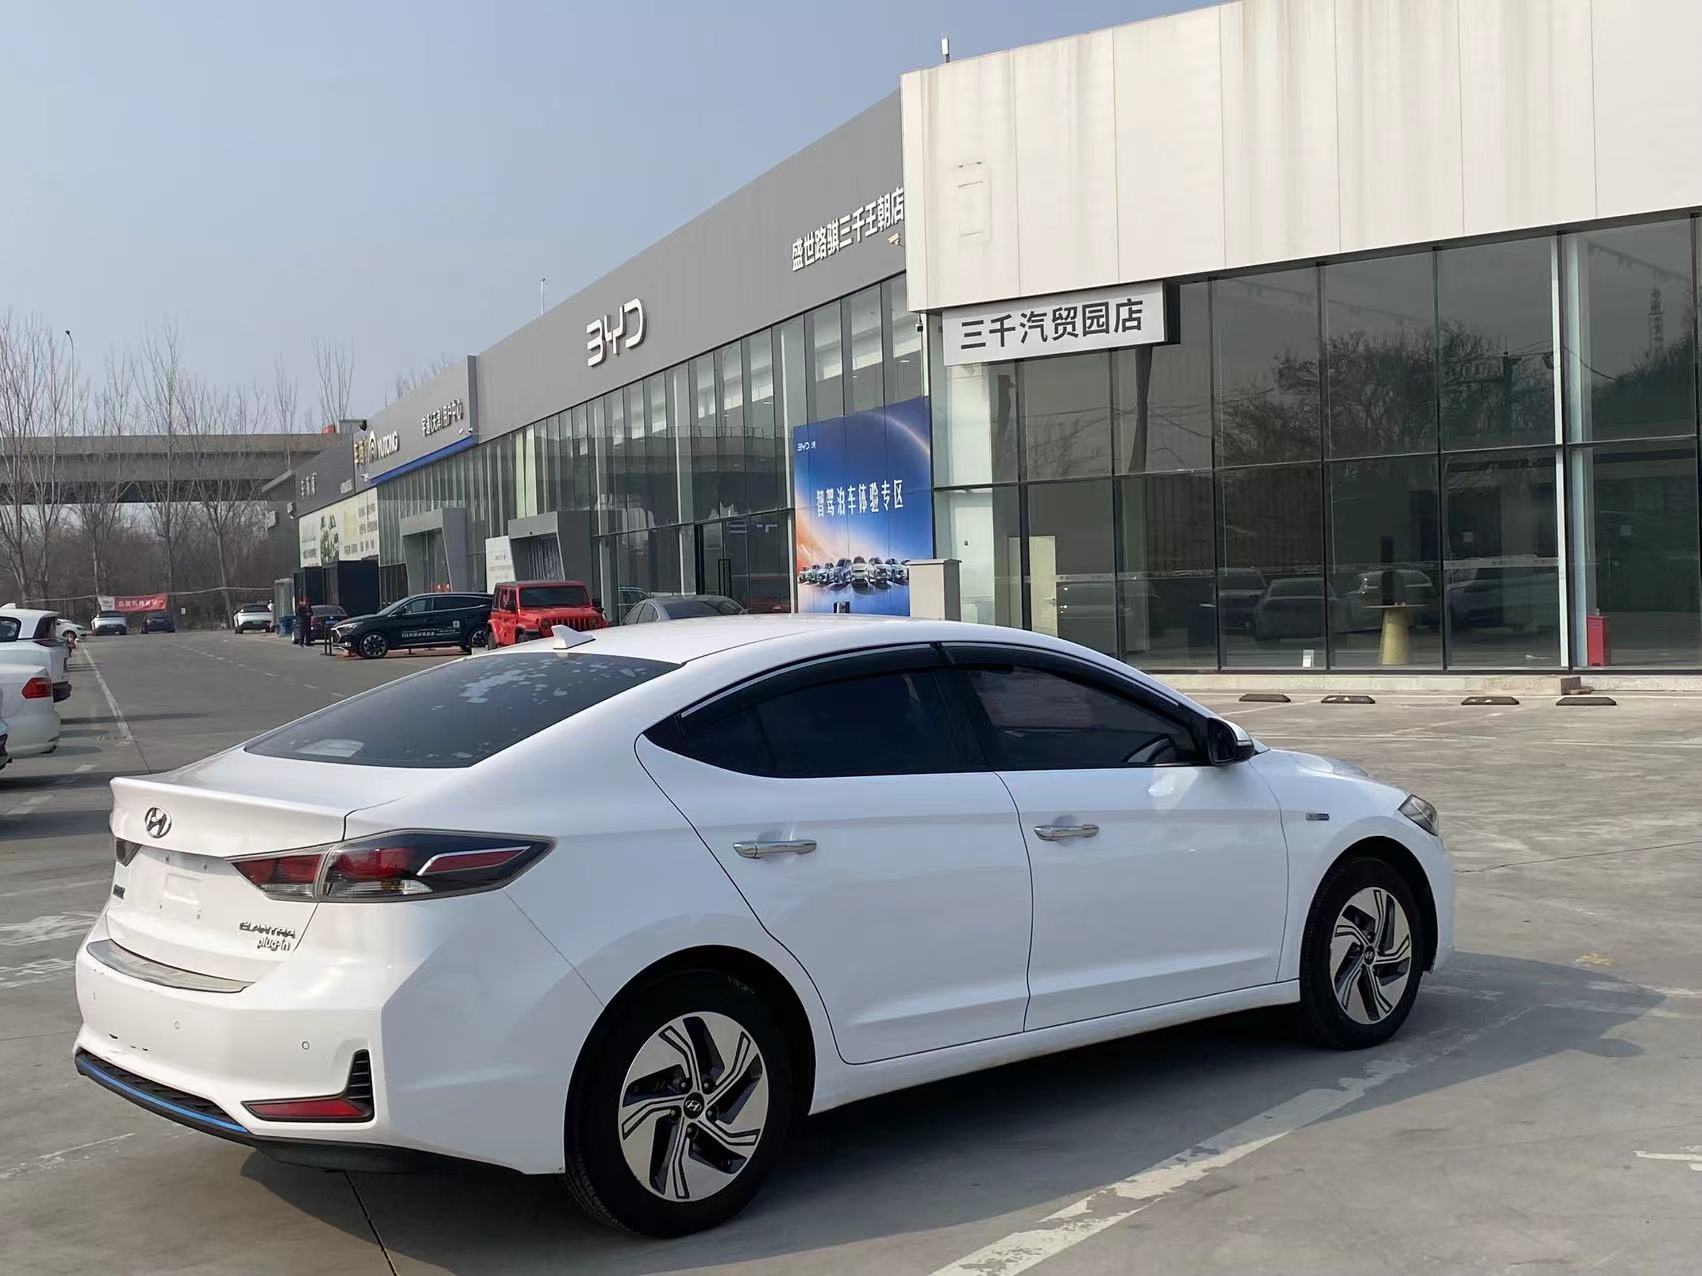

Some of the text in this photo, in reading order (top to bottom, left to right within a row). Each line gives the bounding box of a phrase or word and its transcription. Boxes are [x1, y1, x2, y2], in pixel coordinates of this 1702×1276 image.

[586, 298, 644, 367] BYD
[961, 298, 1143, 350] 三千汽贸园店
[377, 430, 399, 459] YUTONG
[816, 479, 904, 518] 智驾泊车体验专区
[239, 921, 296, 939] ELANTRA
[256, 936, 291, 952] plug-in
